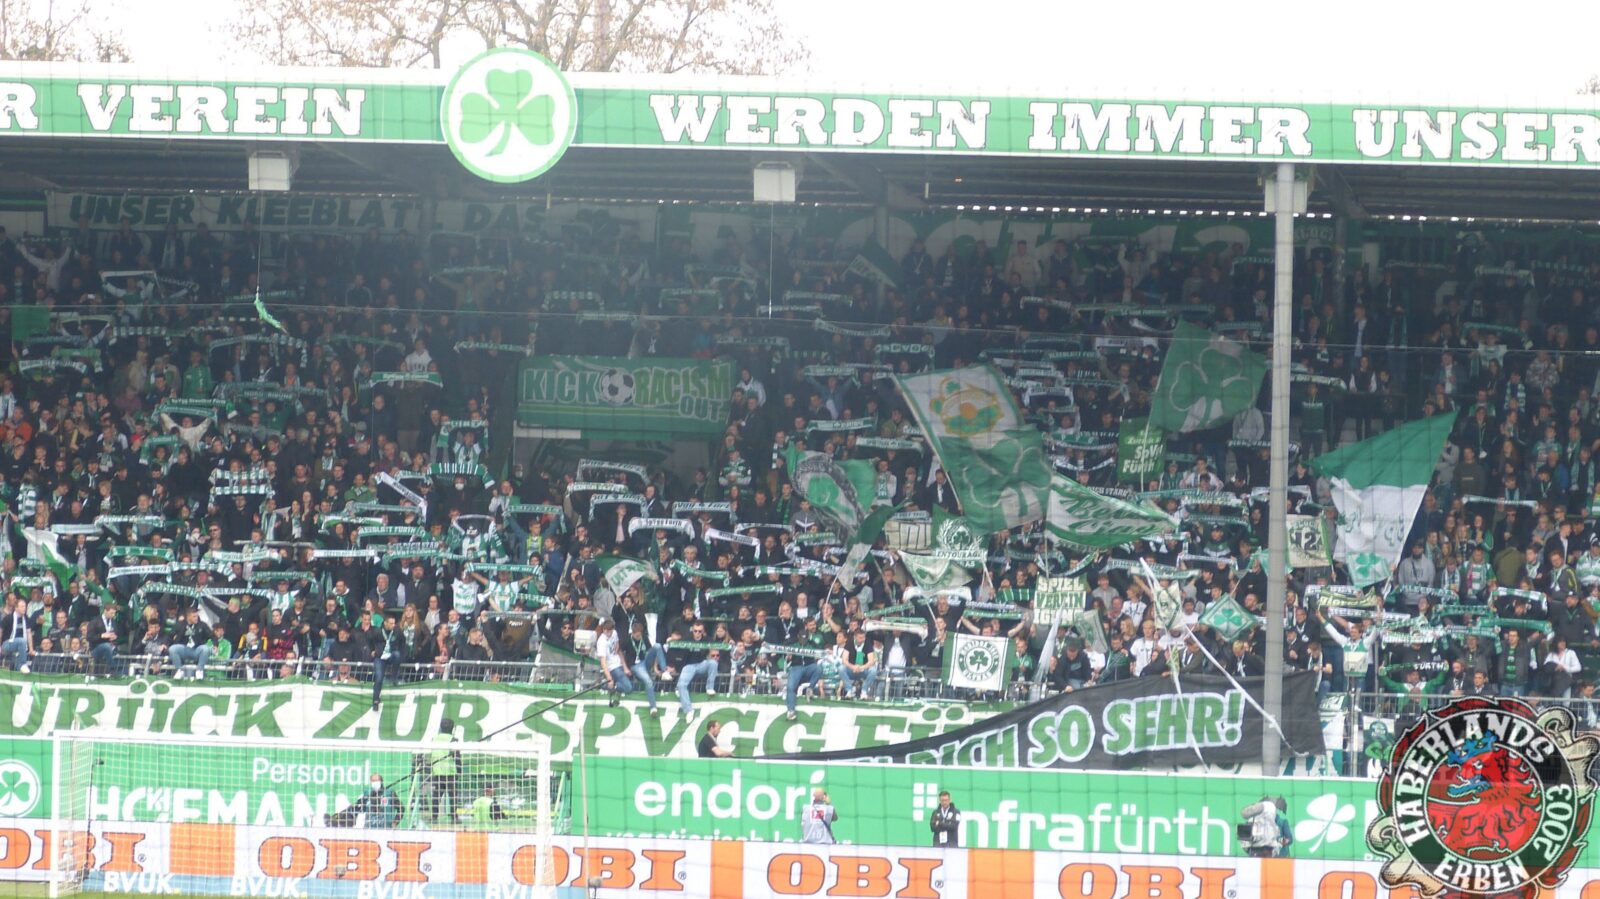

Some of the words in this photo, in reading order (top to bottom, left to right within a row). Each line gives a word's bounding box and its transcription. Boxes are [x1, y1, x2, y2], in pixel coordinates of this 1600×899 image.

[0, 83, 38, 129] R
[76, 83, 366, 136] VEREIN
[649, 94, 992, 149] WERDEN
[1028, 101, 1312, 157] IMMER
[1353, 108, 1600, 163] UNSER
[69, 195, 195, 225] UNSER
[523, 367, 600, 404] KICK
[632, 360, 732, 407] RACISM
[678, 393, 725, 424] OUT
[1035, 592, 1086, 608] VEREIN
[1037, 575, 1084, 593] SPIEL
[313, 692, 490, 742] ZUR
[516, 699, 827, 758] SPVGG
[1027, 705, 1096, 768] SO
[1101, 689, 1245, 756] SEHR!
[252, 757, 371, 786] Personal
[957, 799, 1232, 856] nfrafürth
[258, 835, 432, 883] OBI
[511, 843, 687, 892] OBI
[767, 852, 944, 899] OBI
[1058, 862, 1237, 899] OBI
